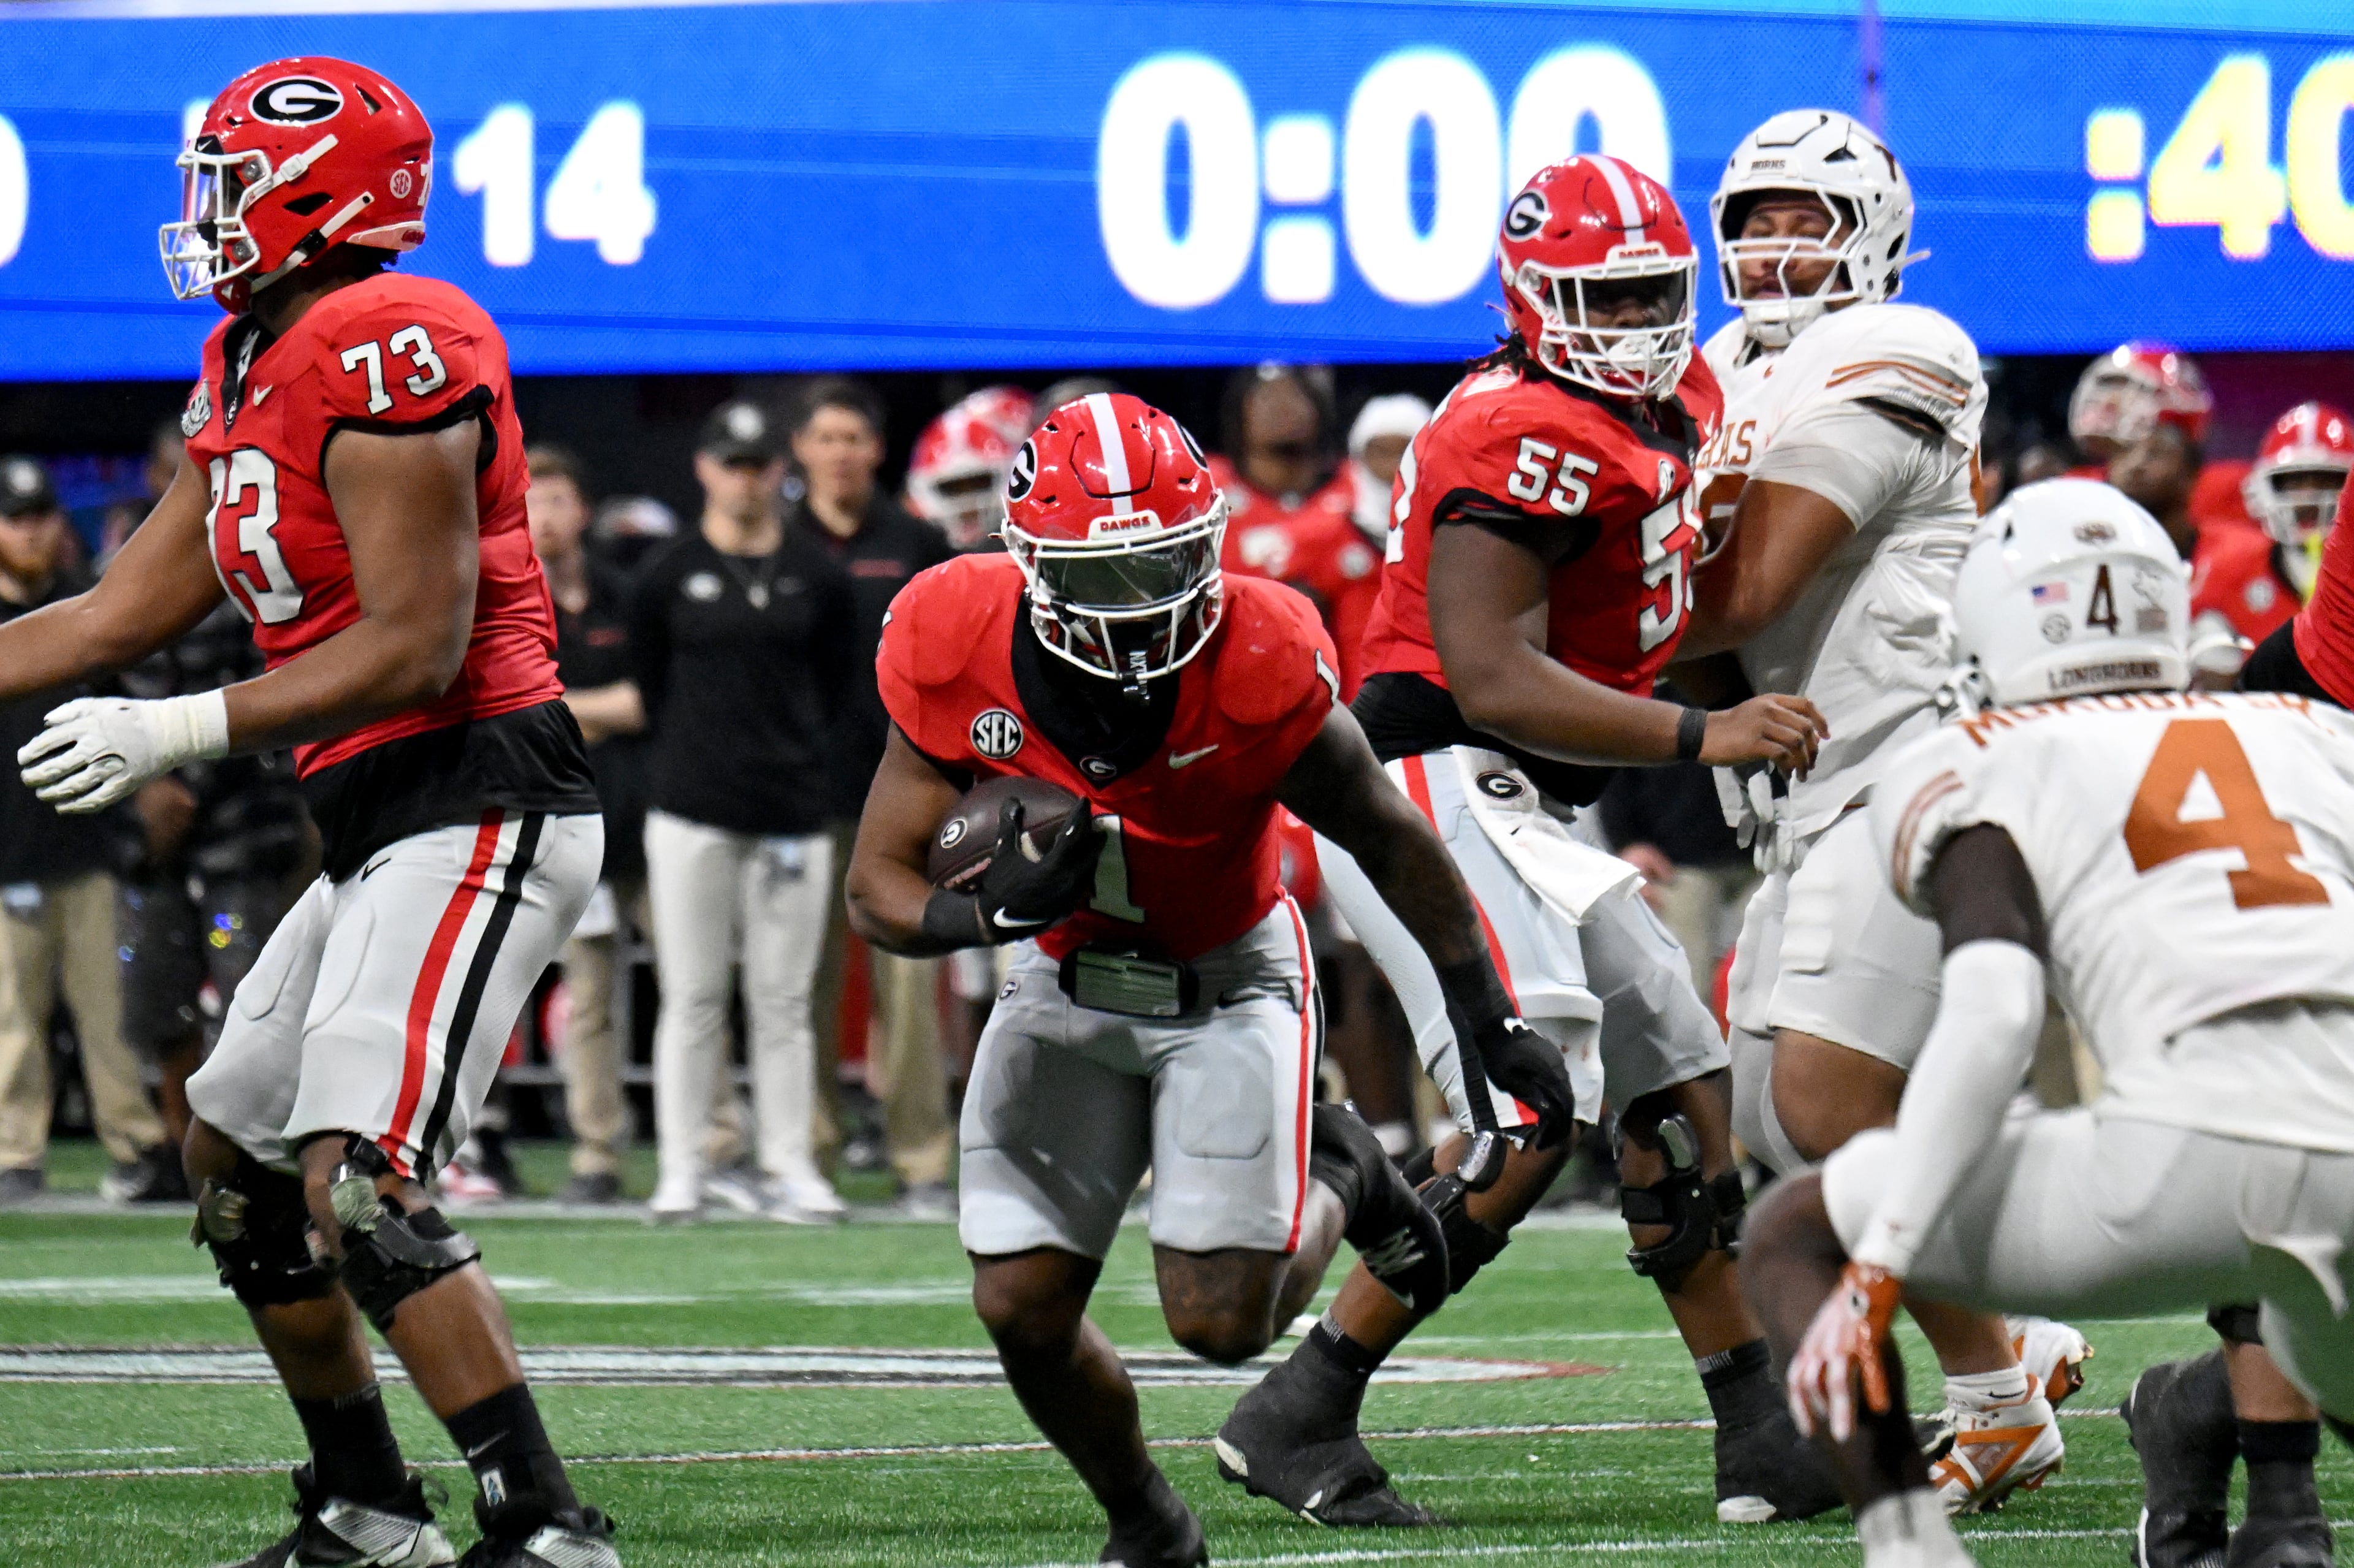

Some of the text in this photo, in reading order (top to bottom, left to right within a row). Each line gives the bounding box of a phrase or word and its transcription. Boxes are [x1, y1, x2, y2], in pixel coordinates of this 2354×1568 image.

[253, 78, 341, 123] G
[452, 99, 657, 265] 14
[1099, 43, 1672, 310] 0:00
[1506, 192, 1544, 237] G
[339, 324, 448, 416] 73
[1507, 436, 1599, 517] 55
[1100, 516, 1151, 531] DAWGS
[2086, 564, 2119, 636] 4
[975, 712, 1019, 755] SEC
[1481, 774, 1523, 796] G
[2124, 718, 2330, 910] 4
[942, 821, 964, 846] G
[1090, 815, 1145, 923] 1
